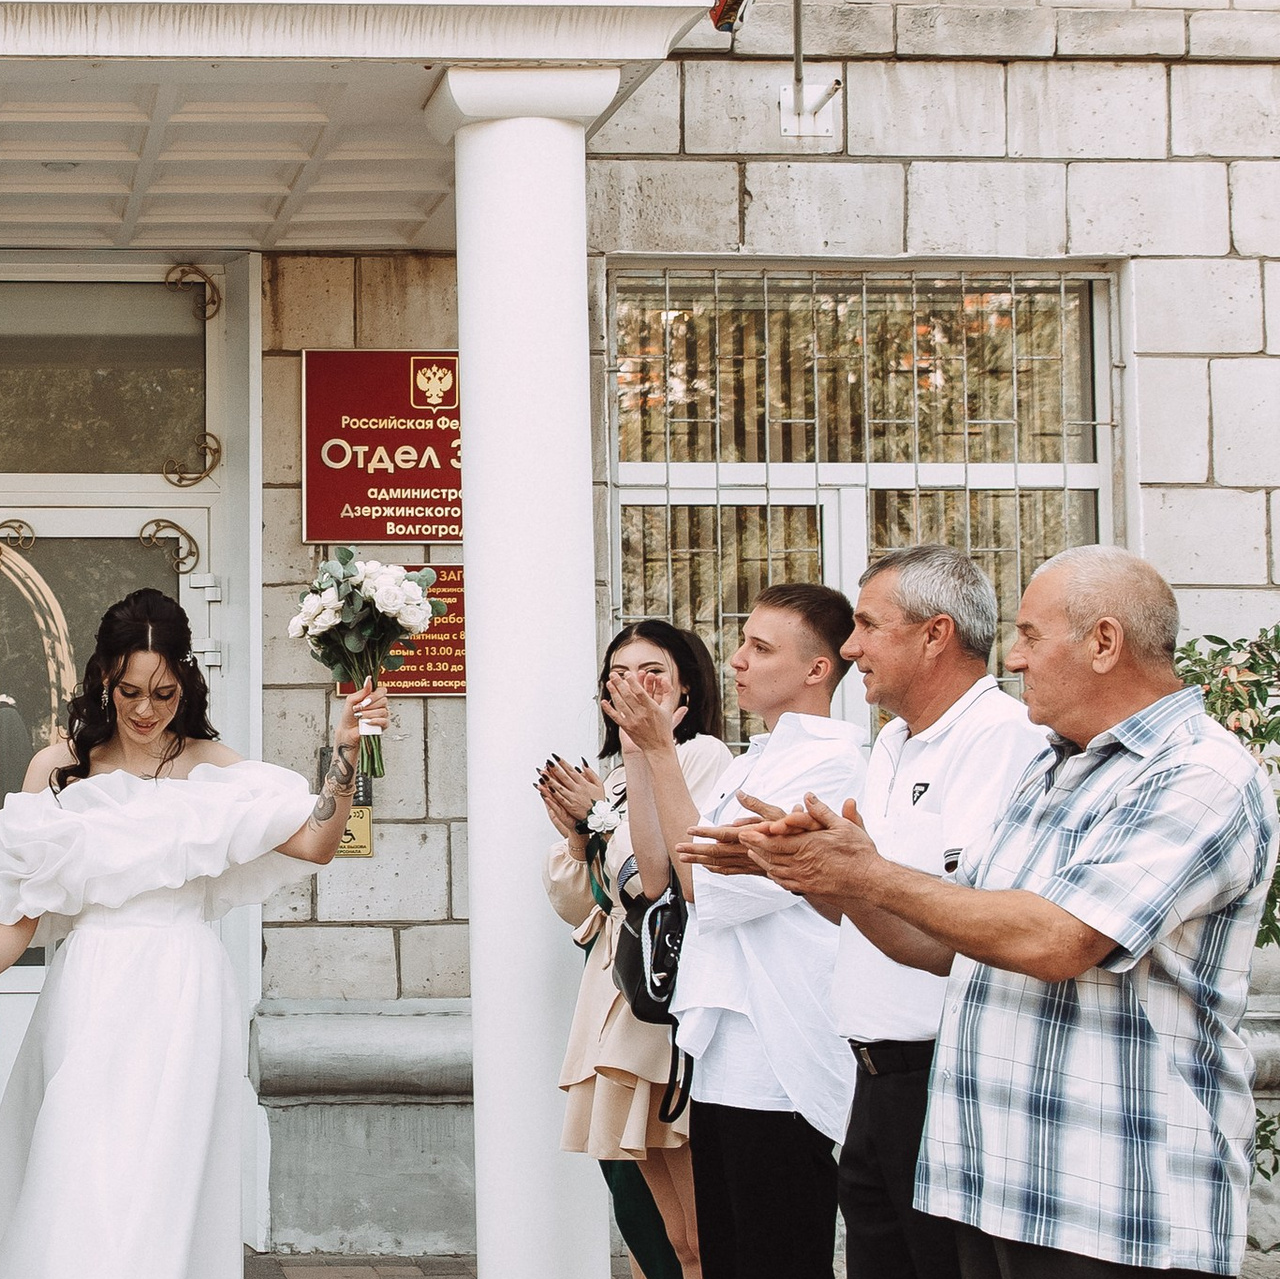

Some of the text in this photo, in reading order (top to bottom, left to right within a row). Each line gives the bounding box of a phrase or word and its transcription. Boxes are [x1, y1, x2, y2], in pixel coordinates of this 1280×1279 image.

[341, 416, 461, 431] Российская Фе
[321, 438, 441, 473] Отдел
[340, 503, 461, 519] Дзержинского
[439, 570, 464, 581] ЗАГ
[425, 646, 453, 656] 13.00
[426, 662, 449, 672] 8.30
[450, 665, 464, 673] до
